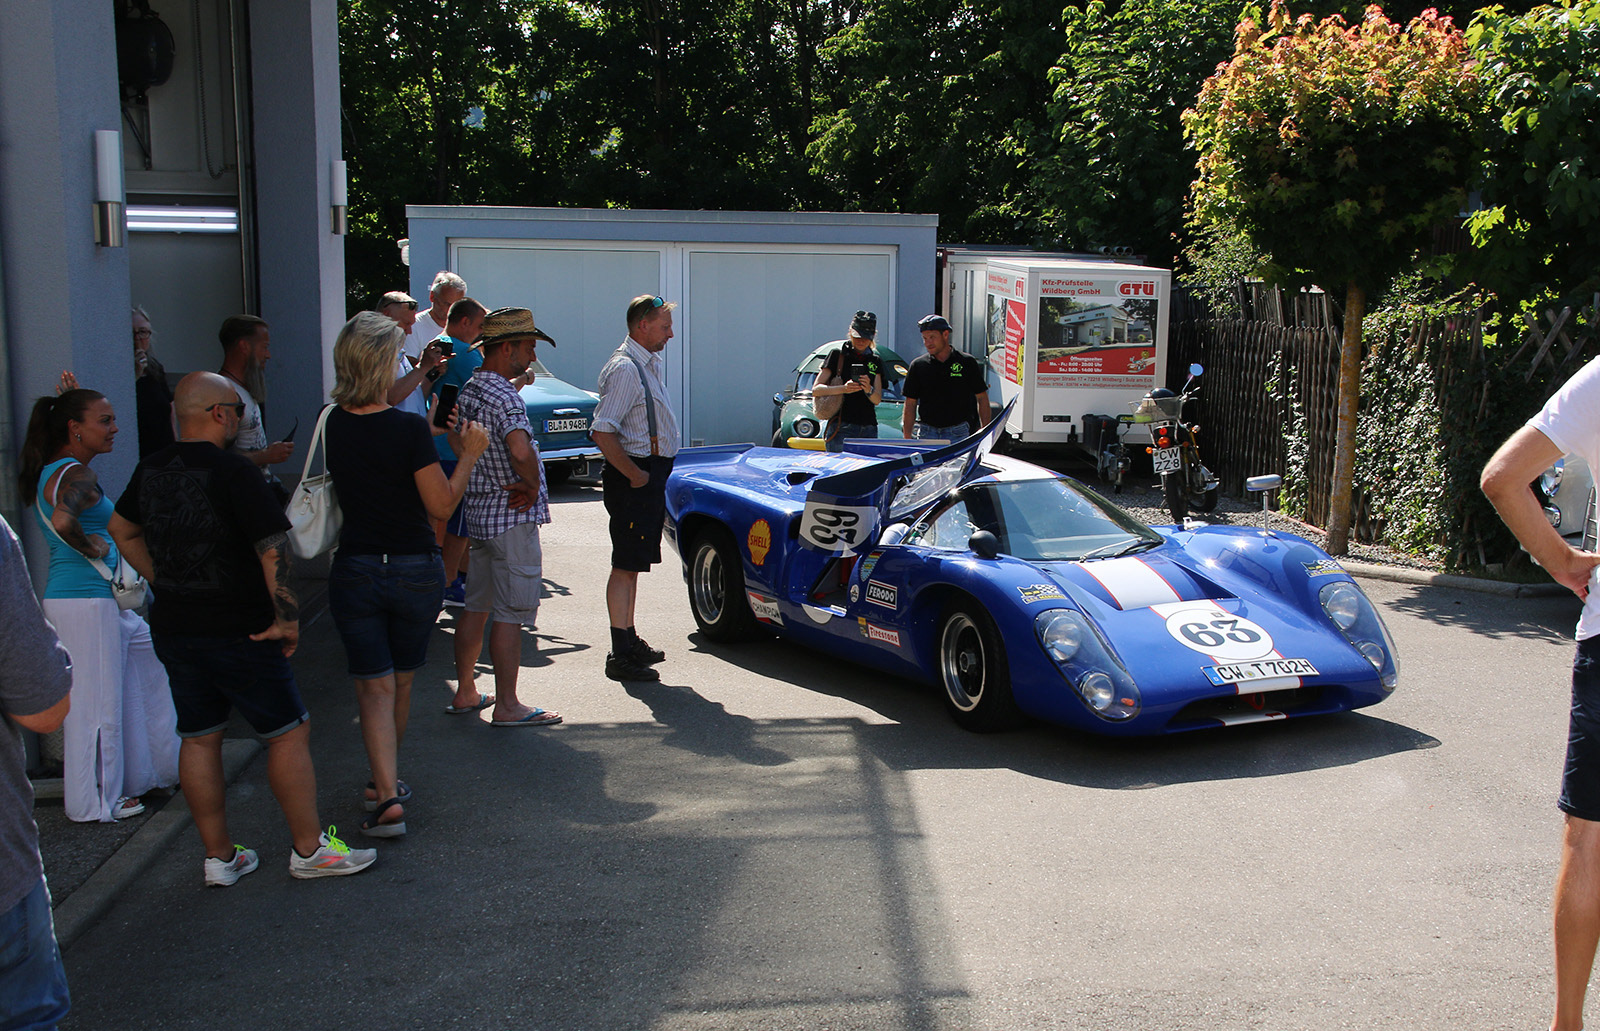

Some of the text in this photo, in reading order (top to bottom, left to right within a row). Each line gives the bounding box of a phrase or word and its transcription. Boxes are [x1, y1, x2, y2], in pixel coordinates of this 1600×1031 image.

[1042, 279, 1094, 287] Kfz-Prüfstelle
[1120, 281, 1154, 295] GTÜ
[548, 419, 587, 431] BL A 948H
[1159, 448, 1179, 461] CW
[1155, 458, 1180, 472] ZZ 8
[810, 508, 860, 544] 63
[750, 534, 768, 549] SHELL
[868, 585, 895, 603] FERODO
[752, 602, 781, 619] CHAMPION
[869, 626, 898, 643] Firestone
[1180, 619, 1261, 647] 63
[1217, 665, 1245, 680] CW
[1251, 663, 1266, 676] T
[1265, 660, 1315, 675] 702H
